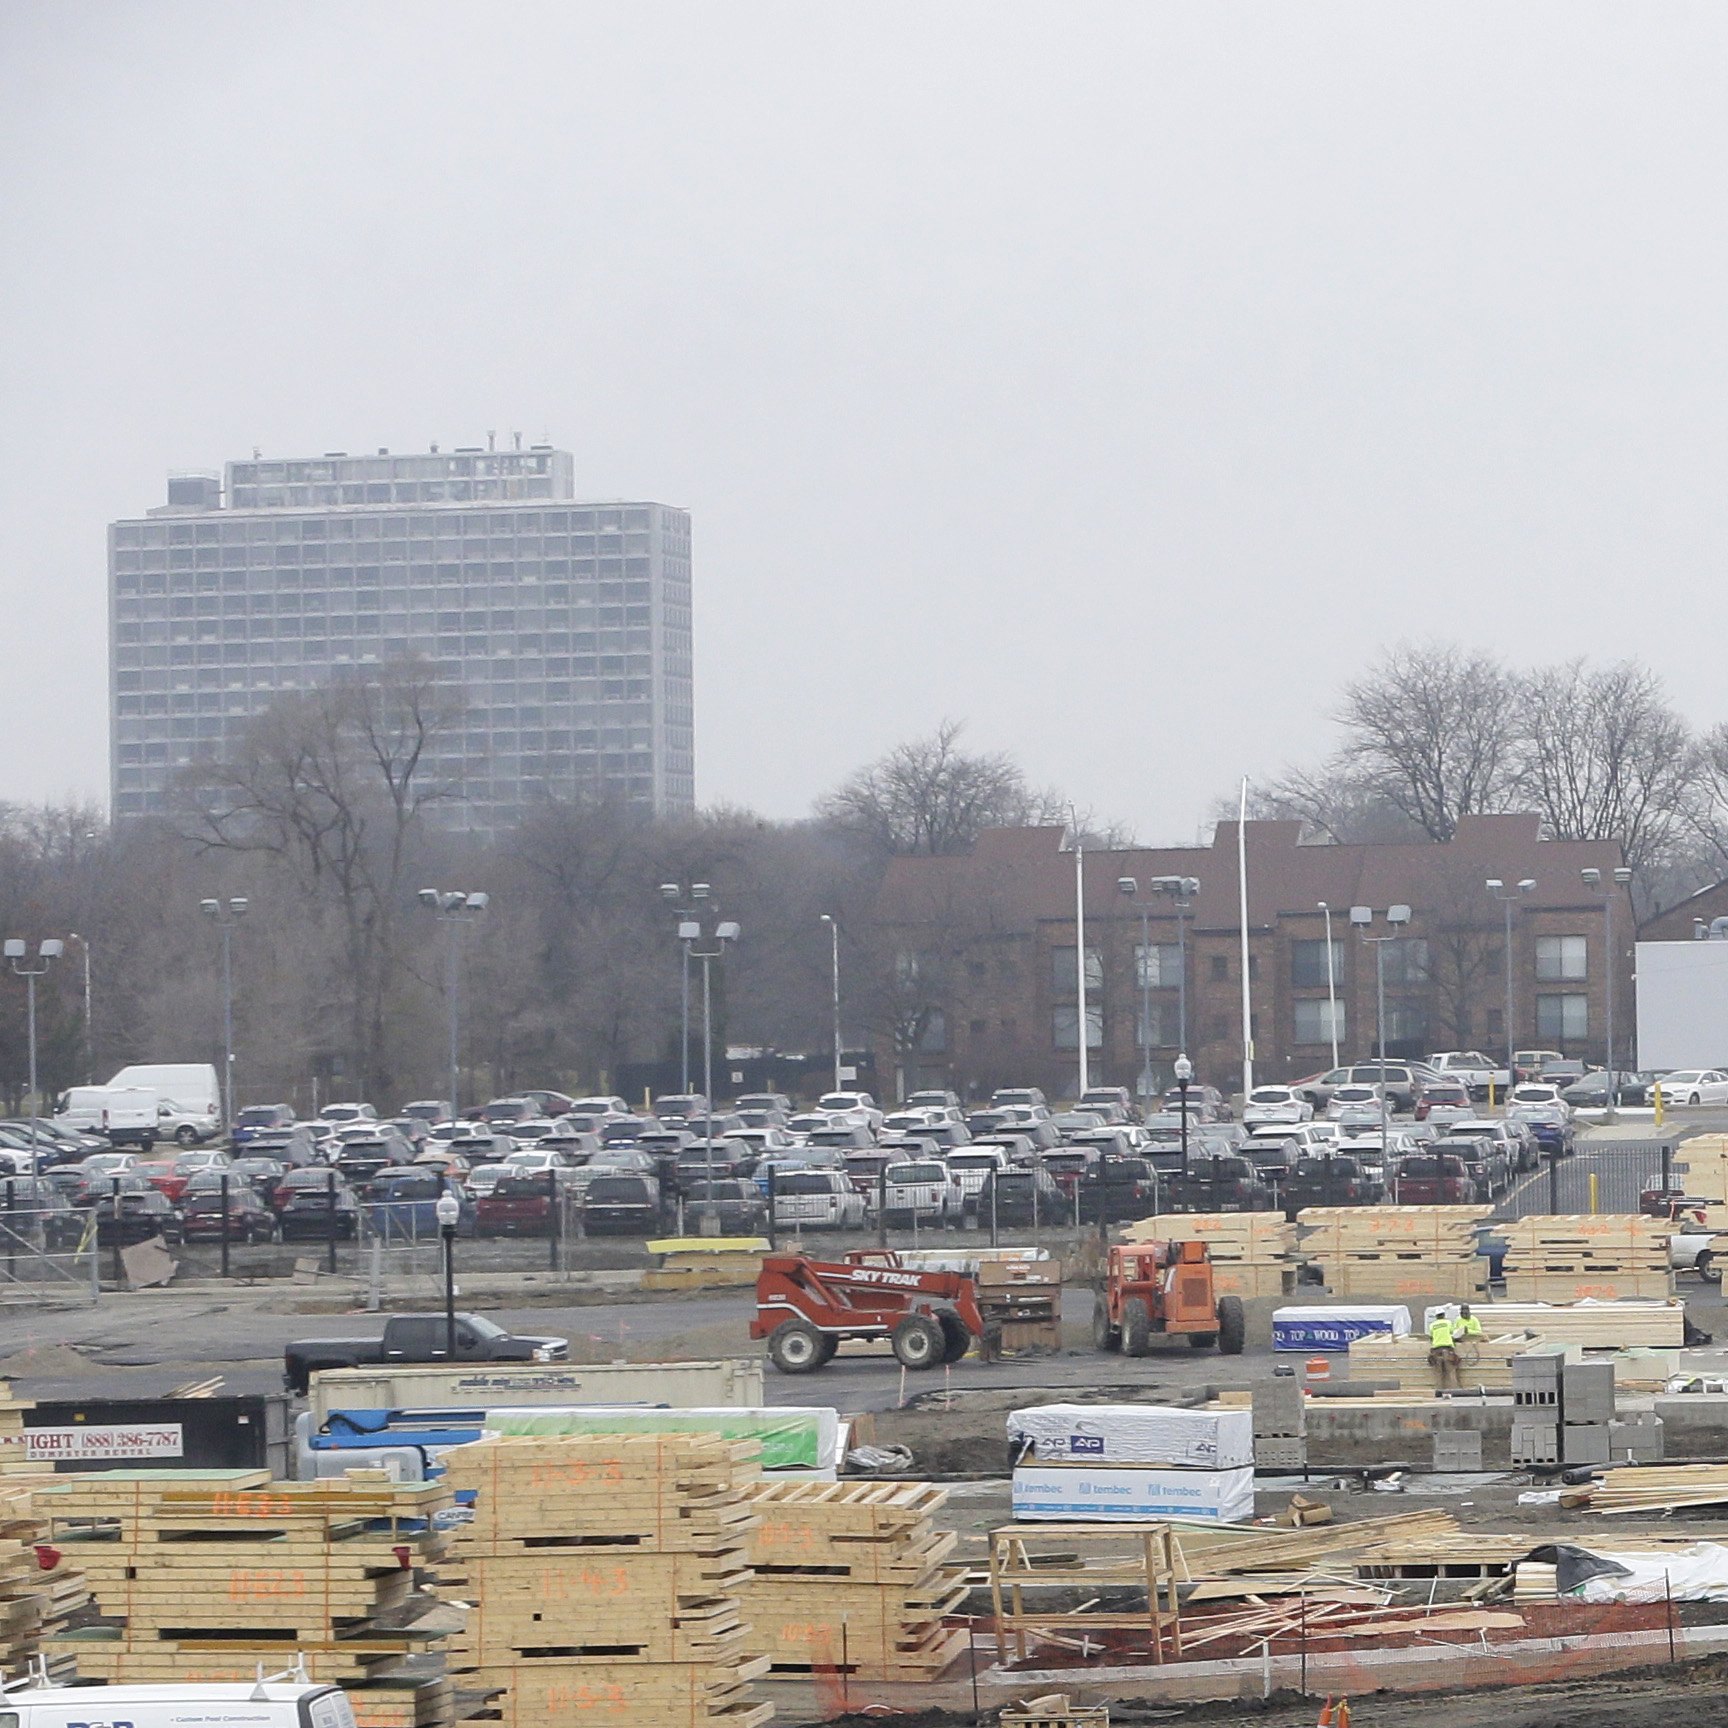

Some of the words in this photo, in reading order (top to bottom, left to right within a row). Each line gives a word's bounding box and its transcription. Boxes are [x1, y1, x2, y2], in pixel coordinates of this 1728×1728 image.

[851, 1269, 881, 1281] SKY
[882, 1272, 922, 1287] TRAK
[81, 1432, 114, 1449] (888)
[117, 1430, 179, 1448] 386-7787
[30, 1449, 97, 1459] DUMPSTER
[104, 1448, 152, 1457] RENTAL
[1024, 1483, 1063, 1495] tembec
[1092, 1484, 1133, 1496] tembec
[1163, 1485, 1202, 1498] tembec
